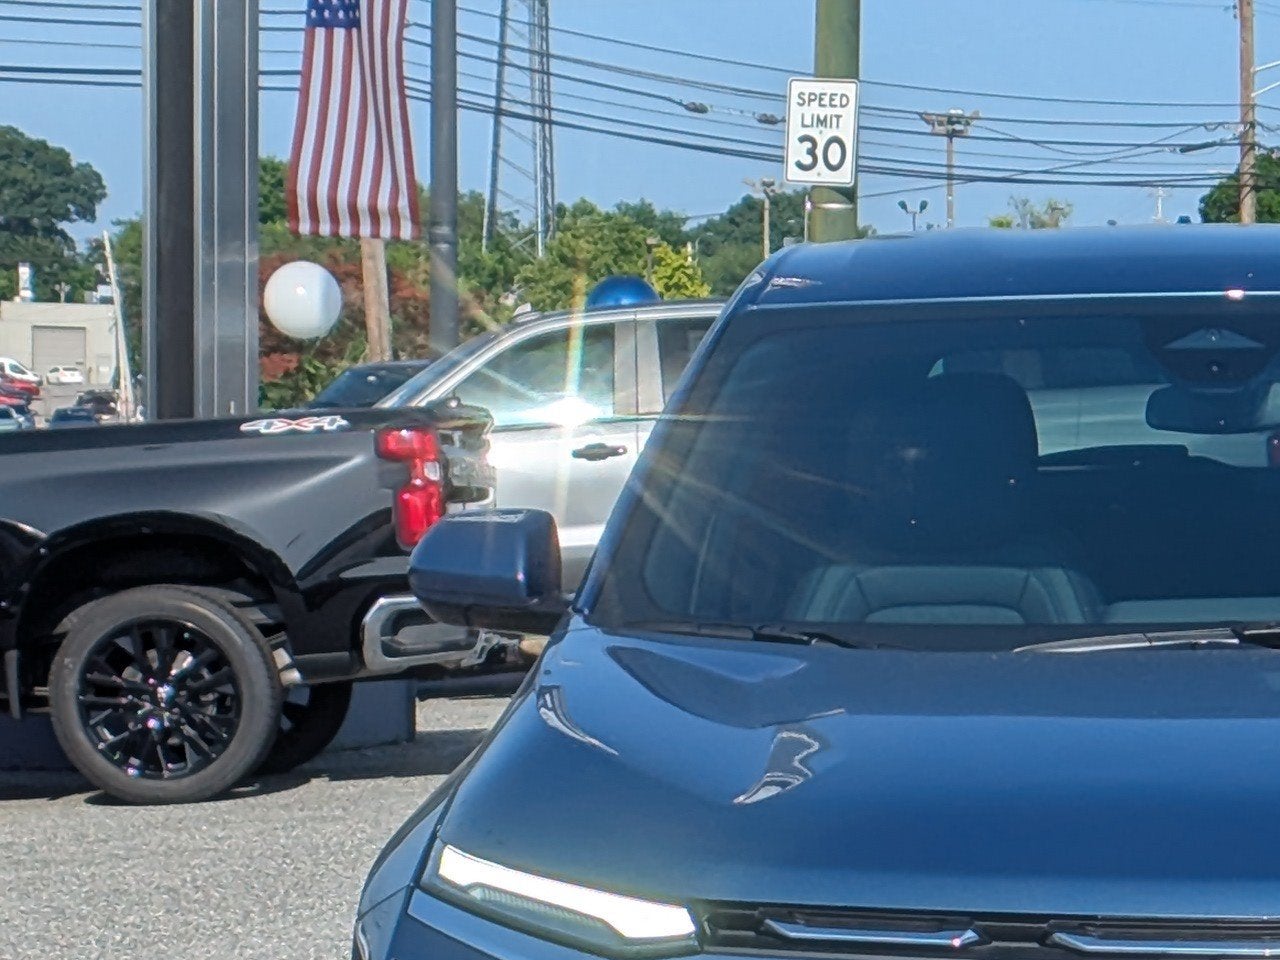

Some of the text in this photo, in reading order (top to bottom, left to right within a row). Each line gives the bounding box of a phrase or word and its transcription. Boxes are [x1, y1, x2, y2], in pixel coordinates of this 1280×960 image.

[797, 92, 850, 108] SPEED
[801, 113, 843, 129] LIMIT
[795, 134, 847, 172] 30
